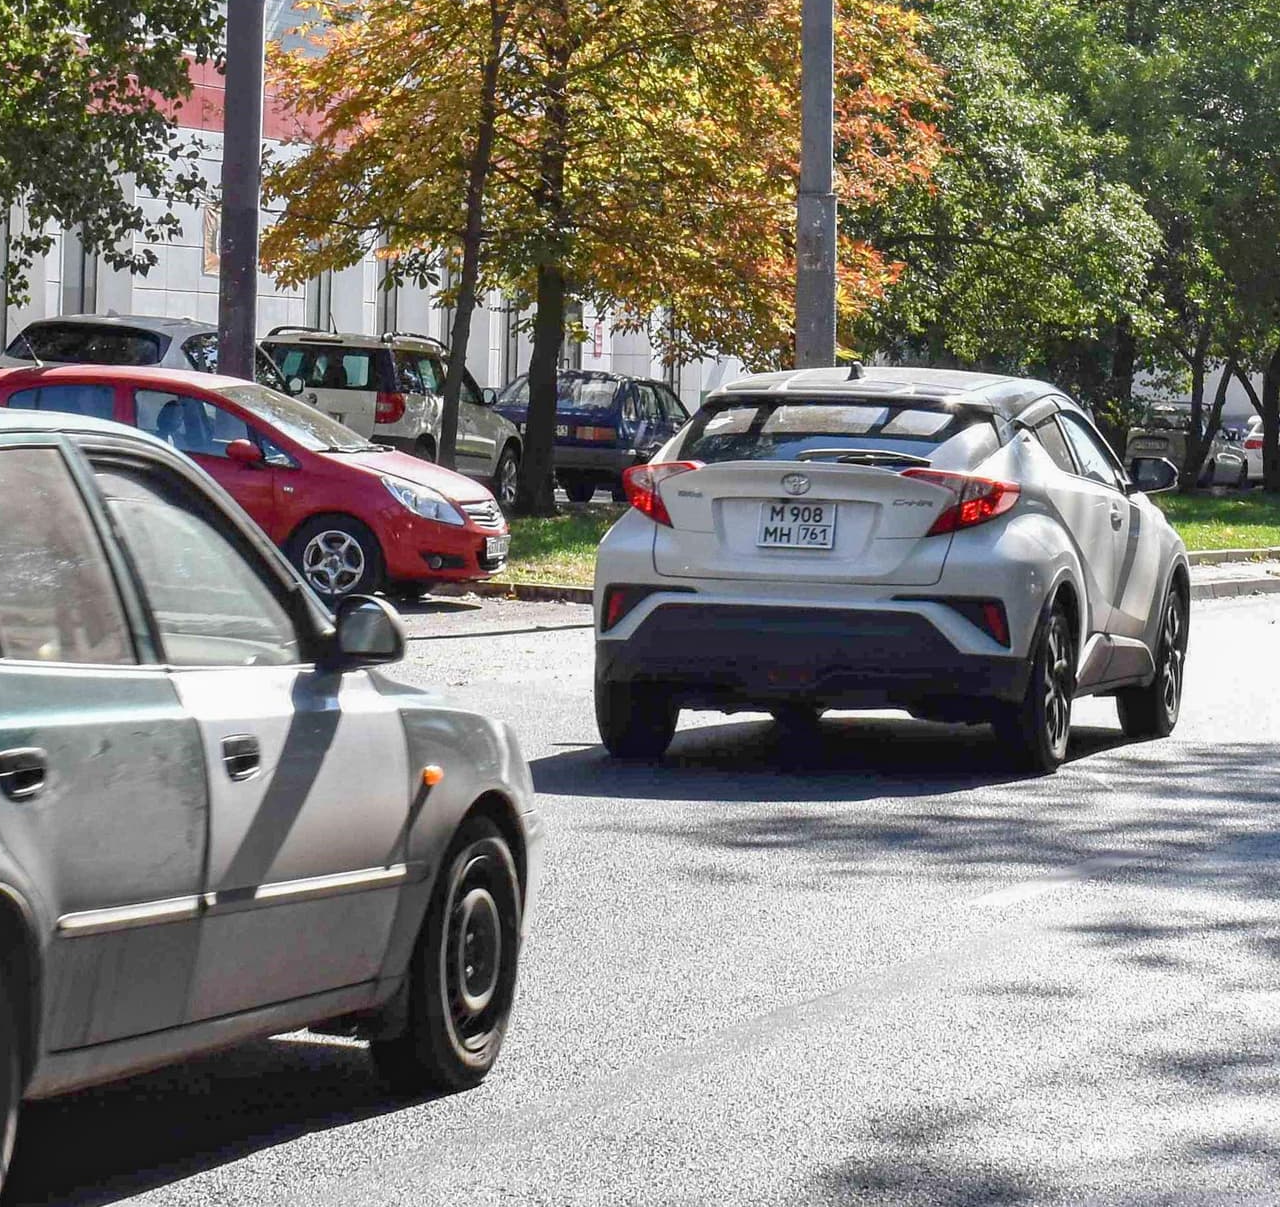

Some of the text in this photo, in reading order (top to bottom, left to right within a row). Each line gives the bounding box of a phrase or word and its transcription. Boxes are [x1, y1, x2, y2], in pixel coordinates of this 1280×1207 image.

[770, 505, 824, 523] М 908
[763, 526, 827, 543] МН 761
